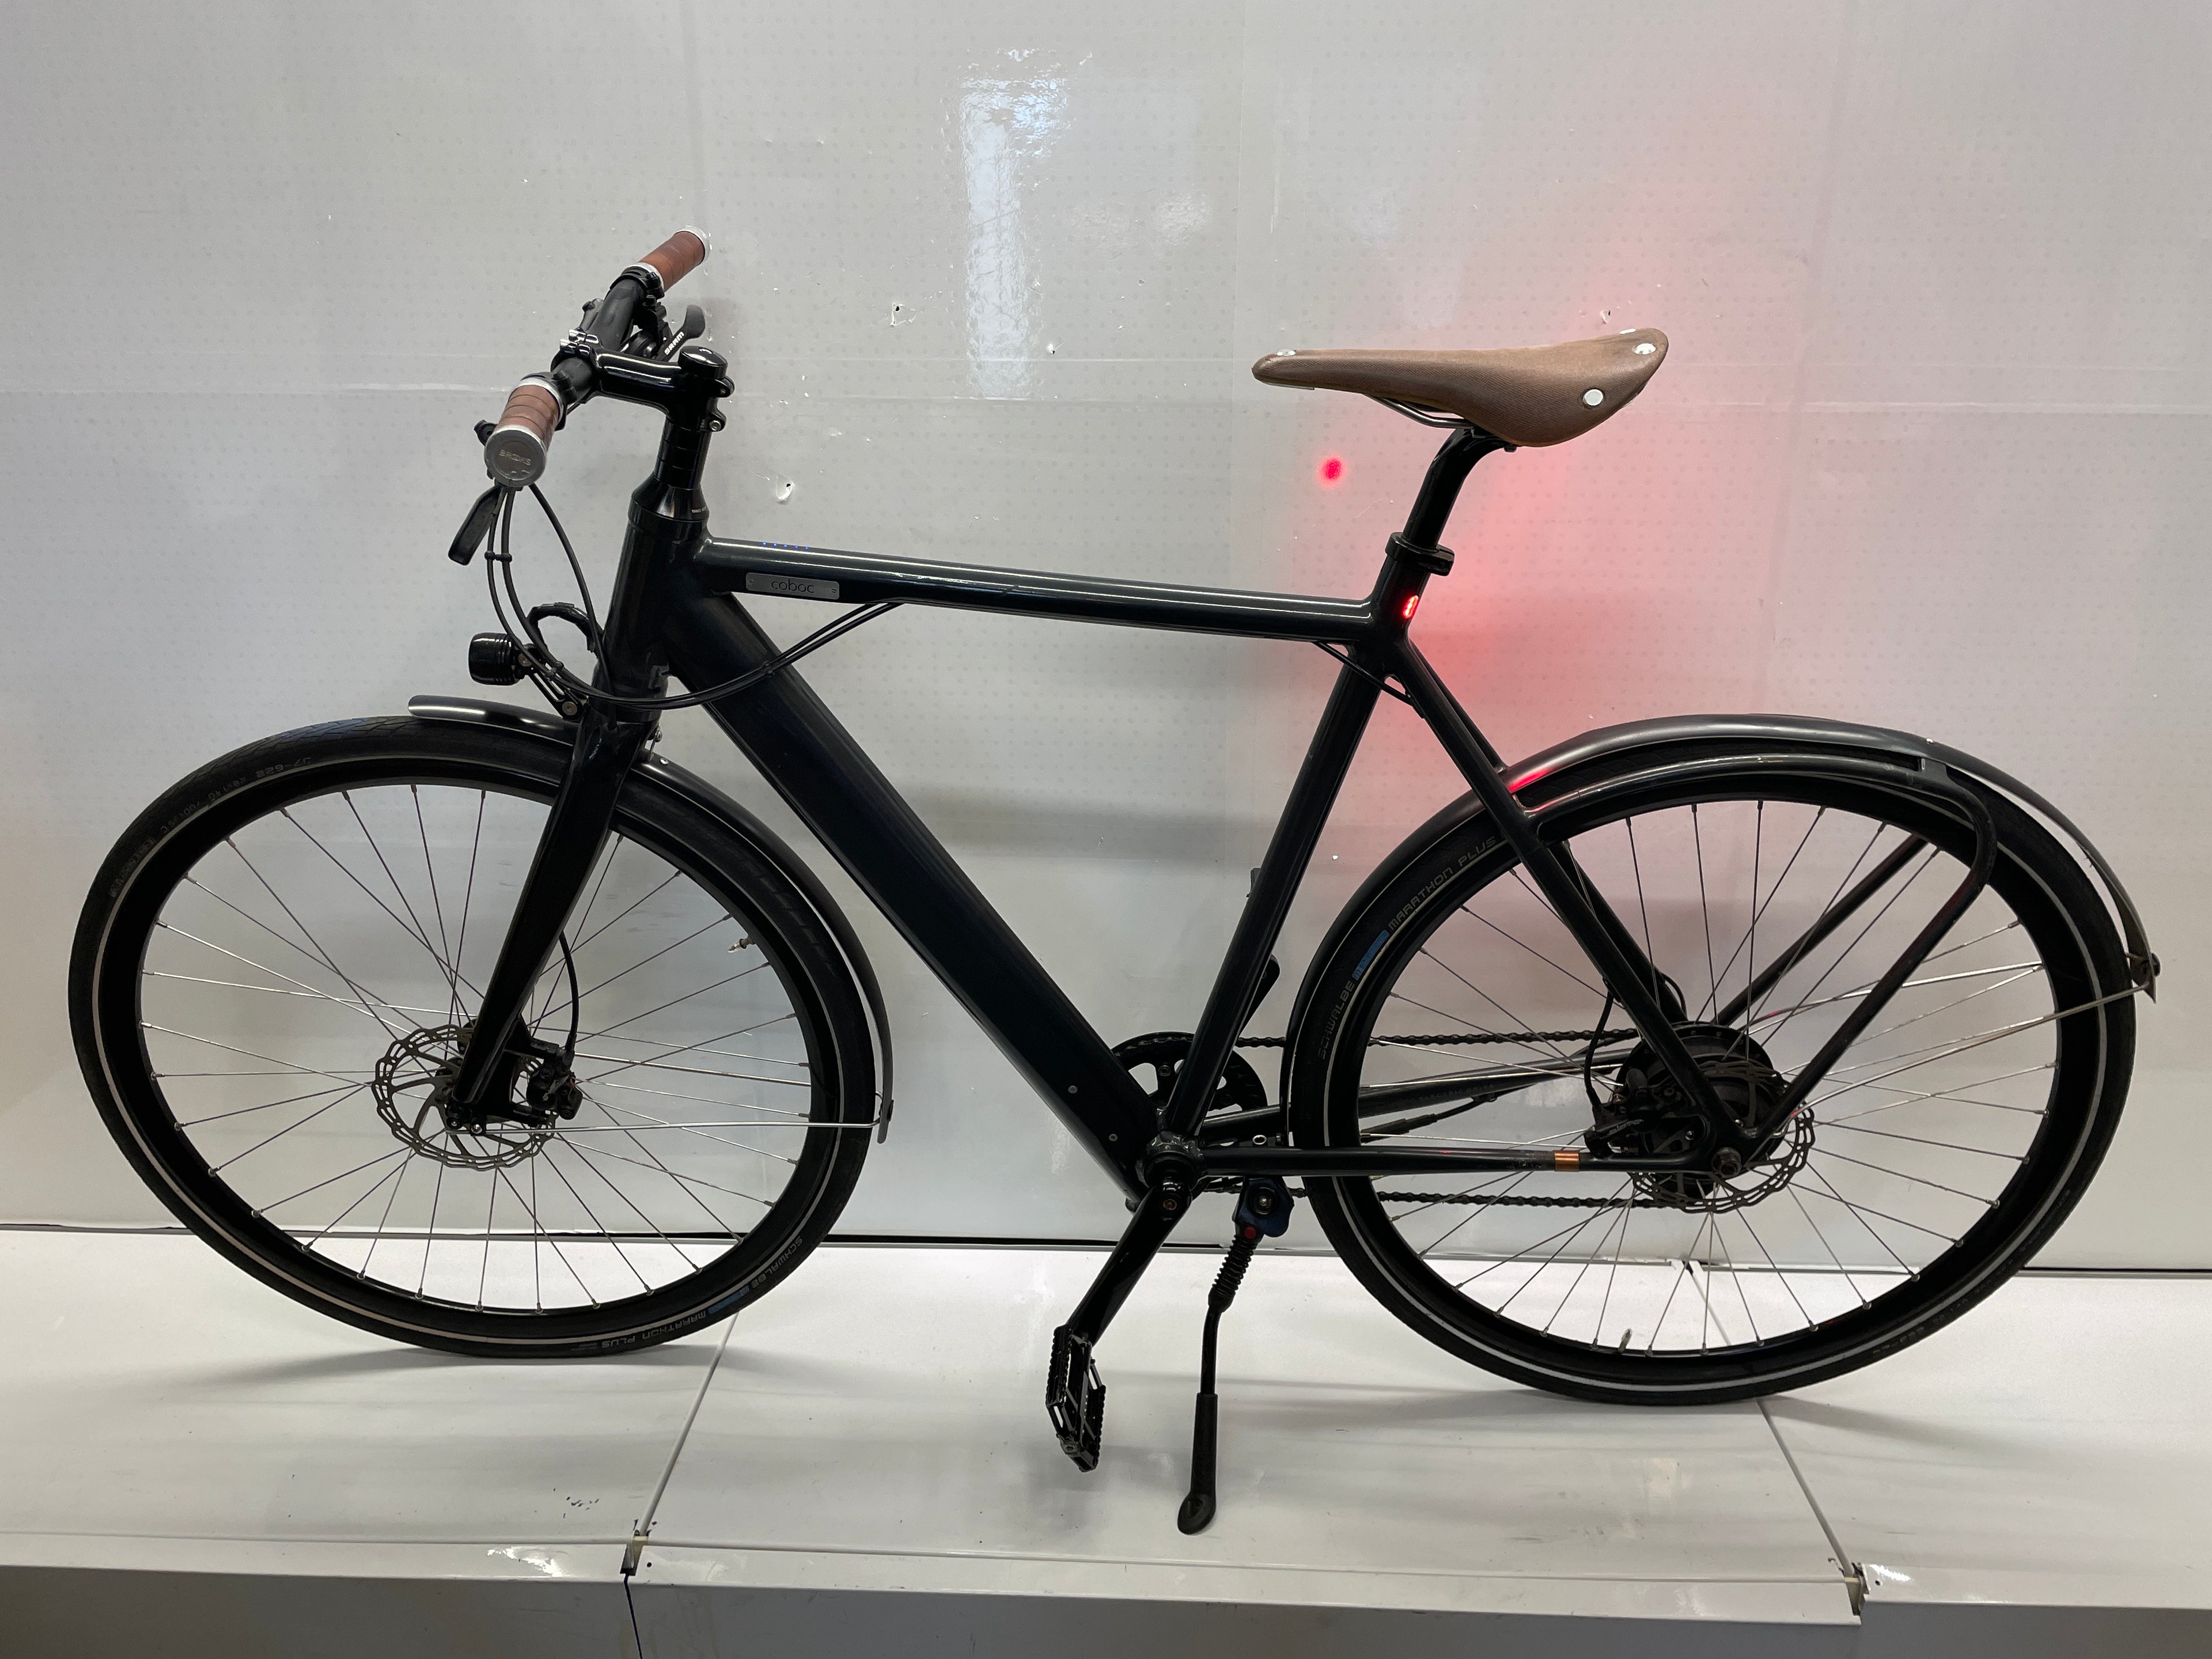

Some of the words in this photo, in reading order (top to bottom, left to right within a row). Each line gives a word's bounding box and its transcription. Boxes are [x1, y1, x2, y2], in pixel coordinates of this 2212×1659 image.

[664, 331, 685, 356] SRAM
[498, 449, 532, 467] BROOKS
[771, 578, 815, 593] coboc
[1317, 980, 1356, 1060] SCHWALBE
[1388, 866, 1454, 931] MARATHON
[1458, 835, 1497, 868] PLUS
[750, 1236, 803, 1289] SCHWALBE
[641, 1310, 707, 1341] MARATHON
[601, 1334, 637, 1349] PLUS
